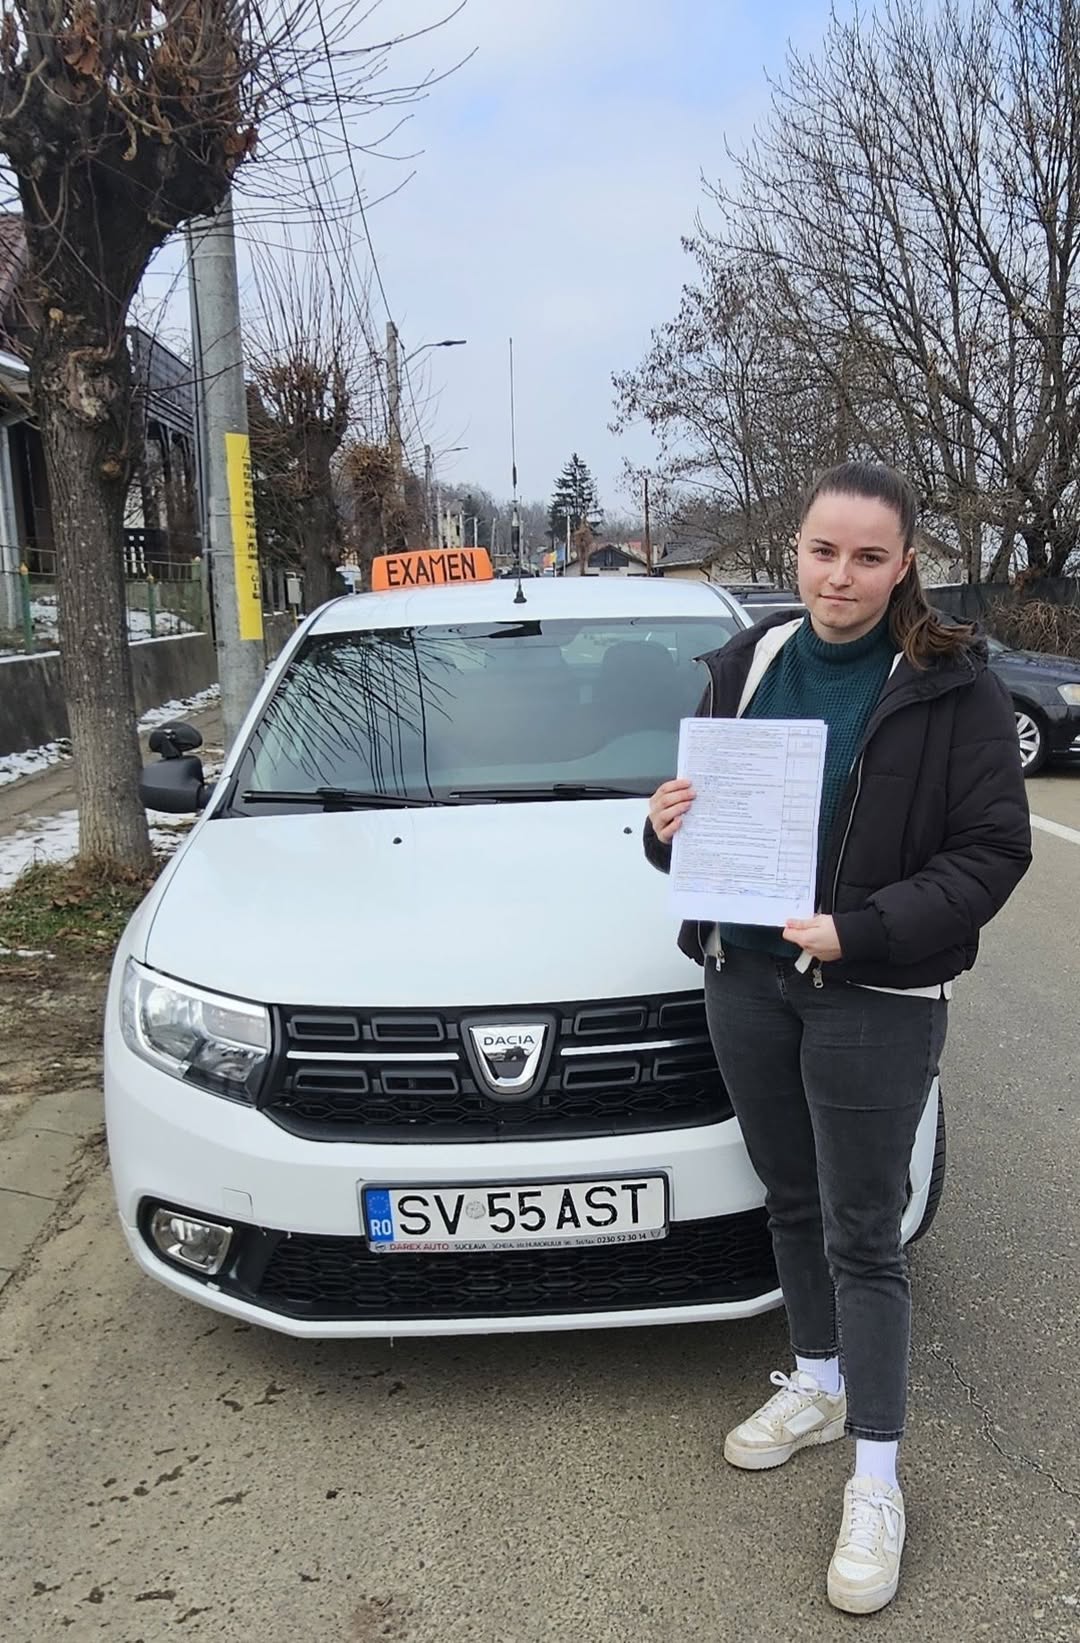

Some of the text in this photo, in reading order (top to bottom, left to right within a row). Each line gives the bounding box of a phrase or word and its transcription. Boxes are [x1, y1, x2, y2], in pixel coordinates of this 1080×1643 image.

[386, 552, 476, 586] EXAMEN
[483, 1035, 535, 1046] DACIA
[371, 1183, 648, 1236] RO SV 55 AST
[454, 1242, 488, 1250] SUCEAVA
[596, 1235, 616, 1244] 0230
[617, 1234, 626, 1242] 52
[628, 1233, 638, 1241] 30
[639, 1232, 647, 1240] 14
